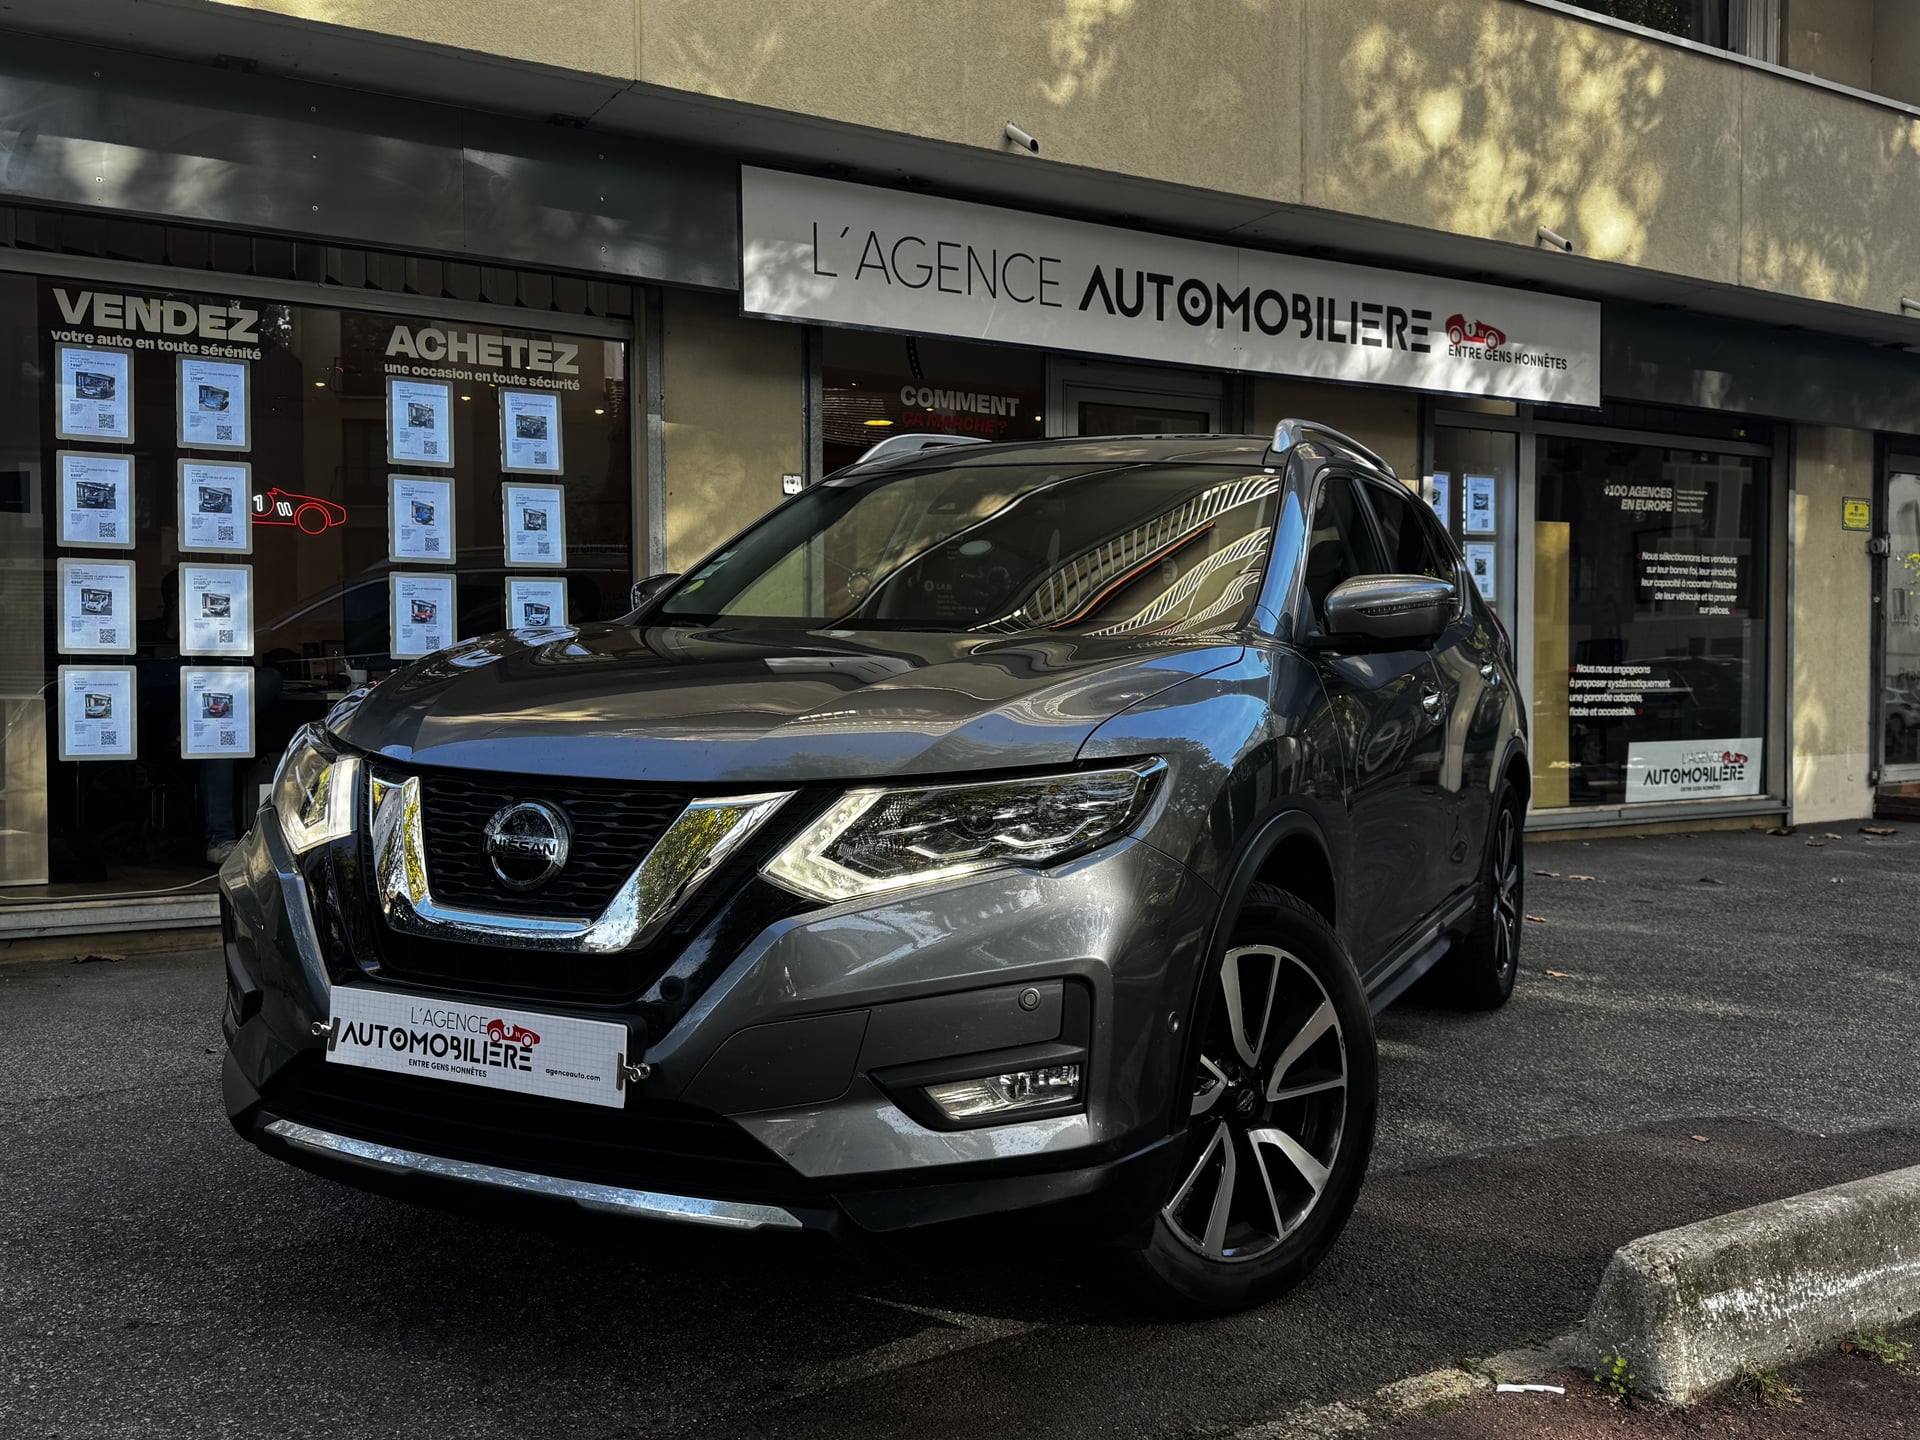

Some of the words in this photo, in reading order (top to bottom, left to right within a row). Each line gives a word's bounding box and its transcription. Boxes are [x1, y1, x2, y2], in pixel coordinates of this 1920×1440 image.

[813, 222, 1063, 308] L'AGENCE
[1078, 264, 1433, 354] AUTOMOBILIERE
[52, 287, 259, 343] VENDEZ
[50, 329, 95, 344] votre
[97, 332, 133, 347] auto
[135, 337, 154, 350] en
[156, 338, 198, 354] toute
[200, 343, 262, 360] sérénité
[384, 325, 579, 375] ACHETEZ
[1448, 344, 1482, 360] ENTRE
[1484, 348, 1512, 363] GENS
[1514, 352, 1568, 370] HONNÊTES
[384, 363, 409, 374] une
[411, 363, 473, 381] occasion
[474, 371, 491, 382] en
[492, 371, 527, 386] toute
[529, 375, 580, 391] sécurité
[900, 385, 1020, 417] COMMENT
[927, 413, 995, 434] MARCHE
[1621, 498, 1635, 510] EN
[1635, 499, 1673, 512] EUROPE
[1628, 486, 1673, 499] AGENCES
[1576, 664, 1595, 674] Nous
[1595, 665, 1613, 674] nous
[1569, 693, 1583, 702] une
[491, 838, 557, 857] NISSAN
[410, 1006, 488, 1035] L'AGENCE
[340, 1020, 533, 1073] AUTOMOBILIERE
[408, 1058, 430, 1069] ENTRE
[430, 1062, 450, 1072] GENS
[451, 1065, 487, 1078] HONNÊTES
[545, 1067, 601, 1082] agenceauto.com
